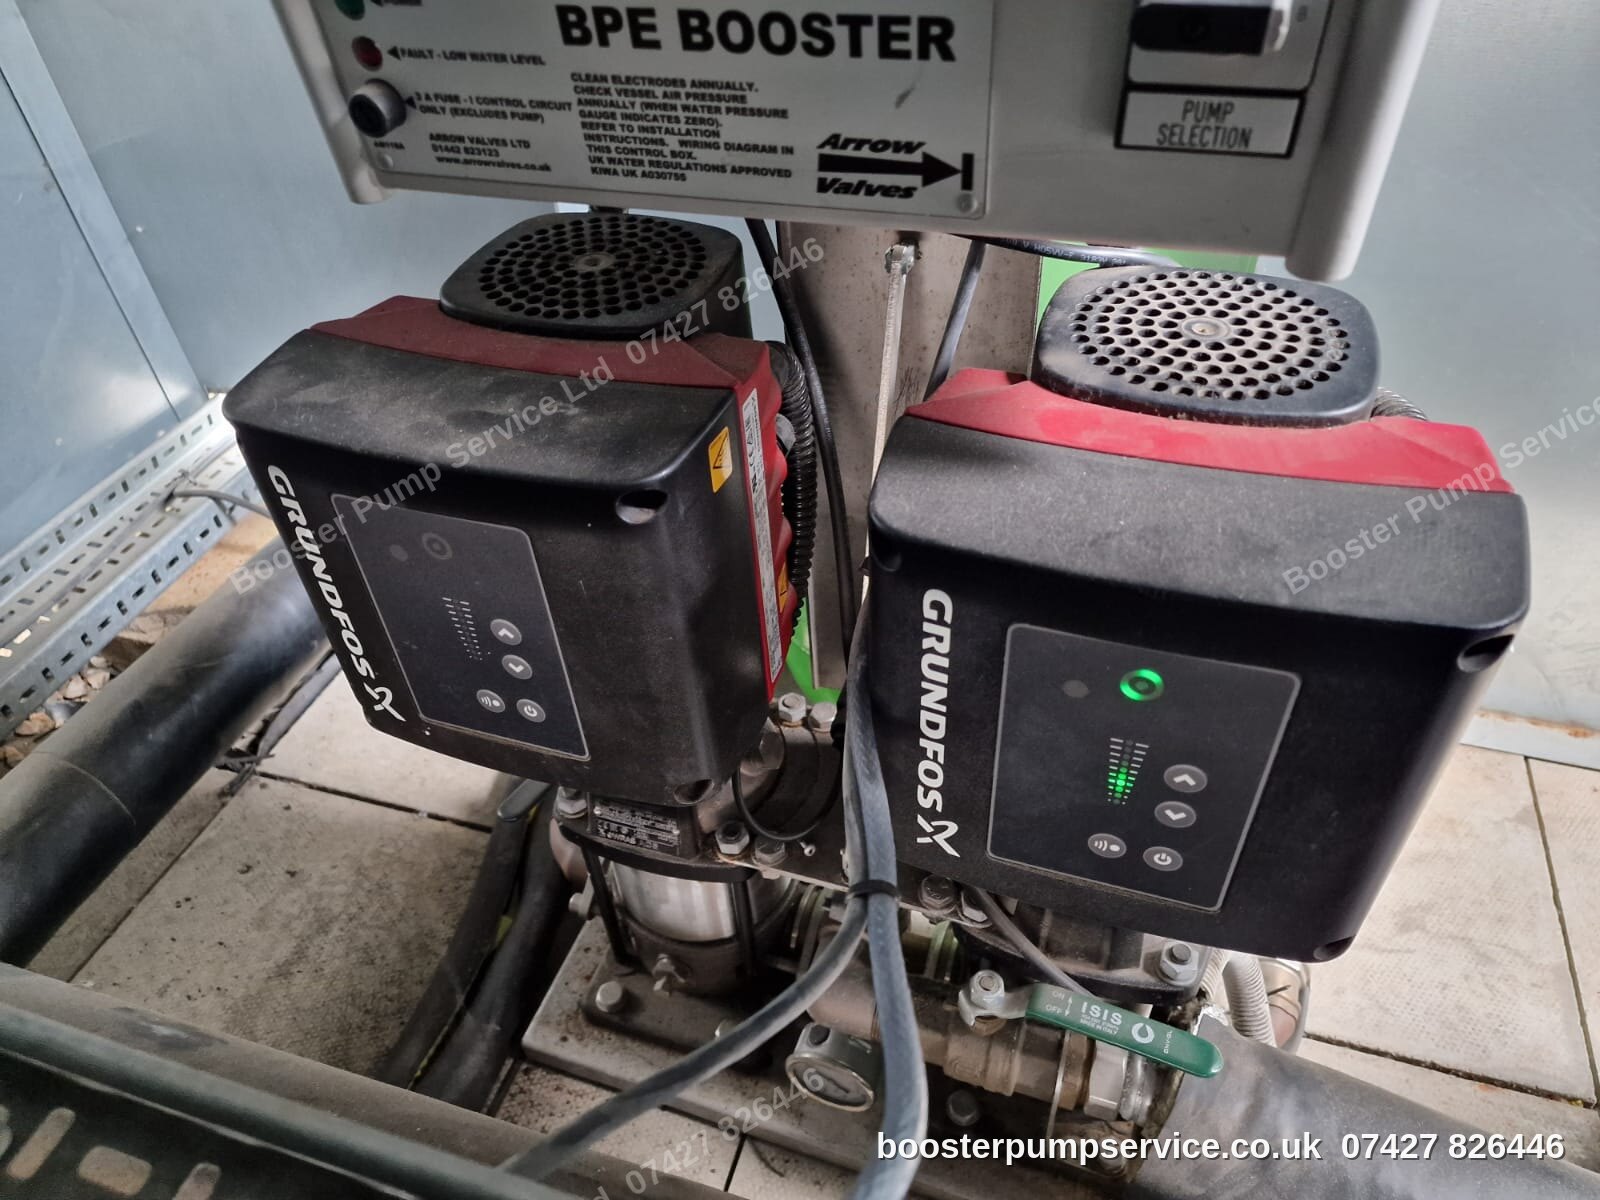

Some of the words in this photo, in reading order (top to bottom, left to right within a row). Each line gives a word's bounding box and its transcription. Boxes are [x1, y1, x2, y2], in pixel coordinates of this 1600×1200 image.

[555, 5, 662, 50] BPE
[677, 9, 956, 62] BOOSTER
[400, 48, 434, 60] FAULT
[444, 50, 467, 62] LOW
[470, 52, 508, 64] WATER
[510, 54, 547, 66] LEVEL
[570, 72, 608, 84] CLEAN
[611, 75, 687, 89] ELECTRODES
[690, 79, 759, 93] ANNUALLY.
[434, 94, 461, 104] FUSE
[475, 97, 526, 109] CONTROL
[529, 100, 572, 113] CIRCUIT
[573, 85, 613, 97] CHECK
[615, 87, 659, 100] VESSEL
[662, 90, 682, 101] AIR
[685, 91, 748, 105] PRESSURE
[419, 104, 447, 115] ONLY
[450, 106, 508, 121] (EXCLUDES
[511, 109, 545, 124] PUMP)
[577, 97, 636, 111] ANNUALLY
[640, 100, 679, 113] (WHEN
[681, 103, 722, 115] WATER
[725, 105, 789, 119] PRESSURE
[1181, 100, 1235, 123] PUMP
[579, 109, 617, 122] GAUGE
[620, 112, 681, 125] INDICATES
[684, 115, 723, 129] ZERO).
[581, 121, 616, 133] REFER
[619, 123, 635, 134] TO
[637, 125, 721, 139] INSTALLATION
[1155, 122, 1253, 150] SELECTION
[429, 133, 465, 145] ARROW
[468, 136, 508, 148] VALVES
[510, 138, 530, 149] LTD
[432, 144, 461, 155] 01442
[584, 132, 669, 148] INSTRUCTIONS.
[678, 139, 721, 151] WIRING
[723, 142, 778, 155] DIAGRAM
[781, 145, 795, 155] IN
[817, 133, 927, 155] Arrow
[586, 143, 612, 155] THIS
[615, 145, 667, 158] CONTROL
[670, 149, 696, 160] BOX.
[436, 156, 551, 172] www.arrowvalves.co.uk
[588, 154, 605, 165] UK
[607, 156, 645, 169] WATER
[648, 159, 727, 174] REGULATIONS
[730, 165, 792, 179] APPROVED
[590, 166, 620, 177] KIWA
[621, 168, 638, 178] UK
[816, 176, 918, 199] Valves
[267, 464, 376, 680] GRUNDFOS
[916, 588, 953, 813] GRUNDFOS
[1052, 991, 1065, 1000] ON
[1045, 1003, 1063, 1015] OFF
[1080, 1002, 1123, 1026] ISIS
[1101, 1024, 1119, 1035] ITALY
